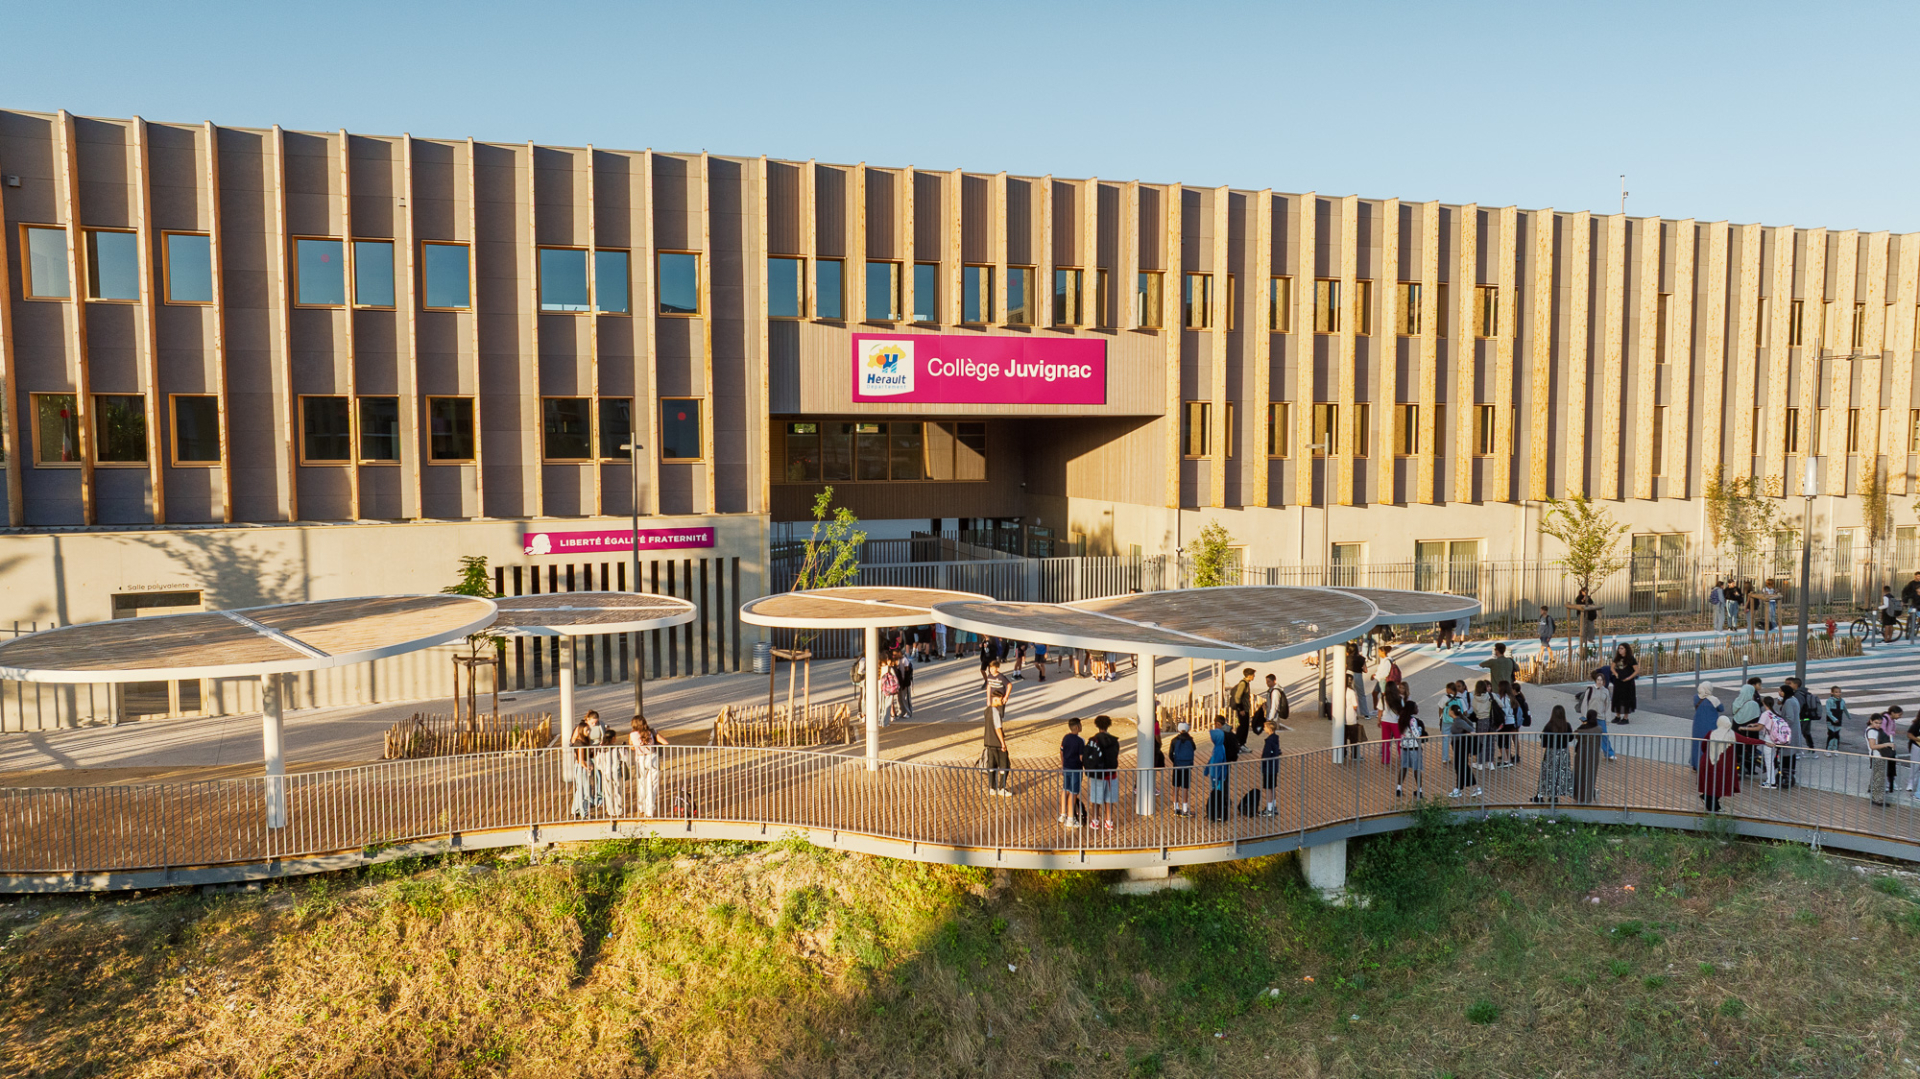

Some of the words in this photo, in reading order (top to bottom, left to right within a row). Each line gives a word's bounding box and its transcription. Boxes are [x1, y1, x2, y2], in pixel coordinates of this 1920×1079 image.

[927, 357, 1000, 382] Collège
[1004, 359, 1092, 382] Juvignac
[560, 536, 602, 547] LIBERTÉ
[604, 534, 646, 545] ÉGALIÉ
[648, 532, 708, 543] FRATERNITÉ
[147, 583, 190, 591] polyvalente
